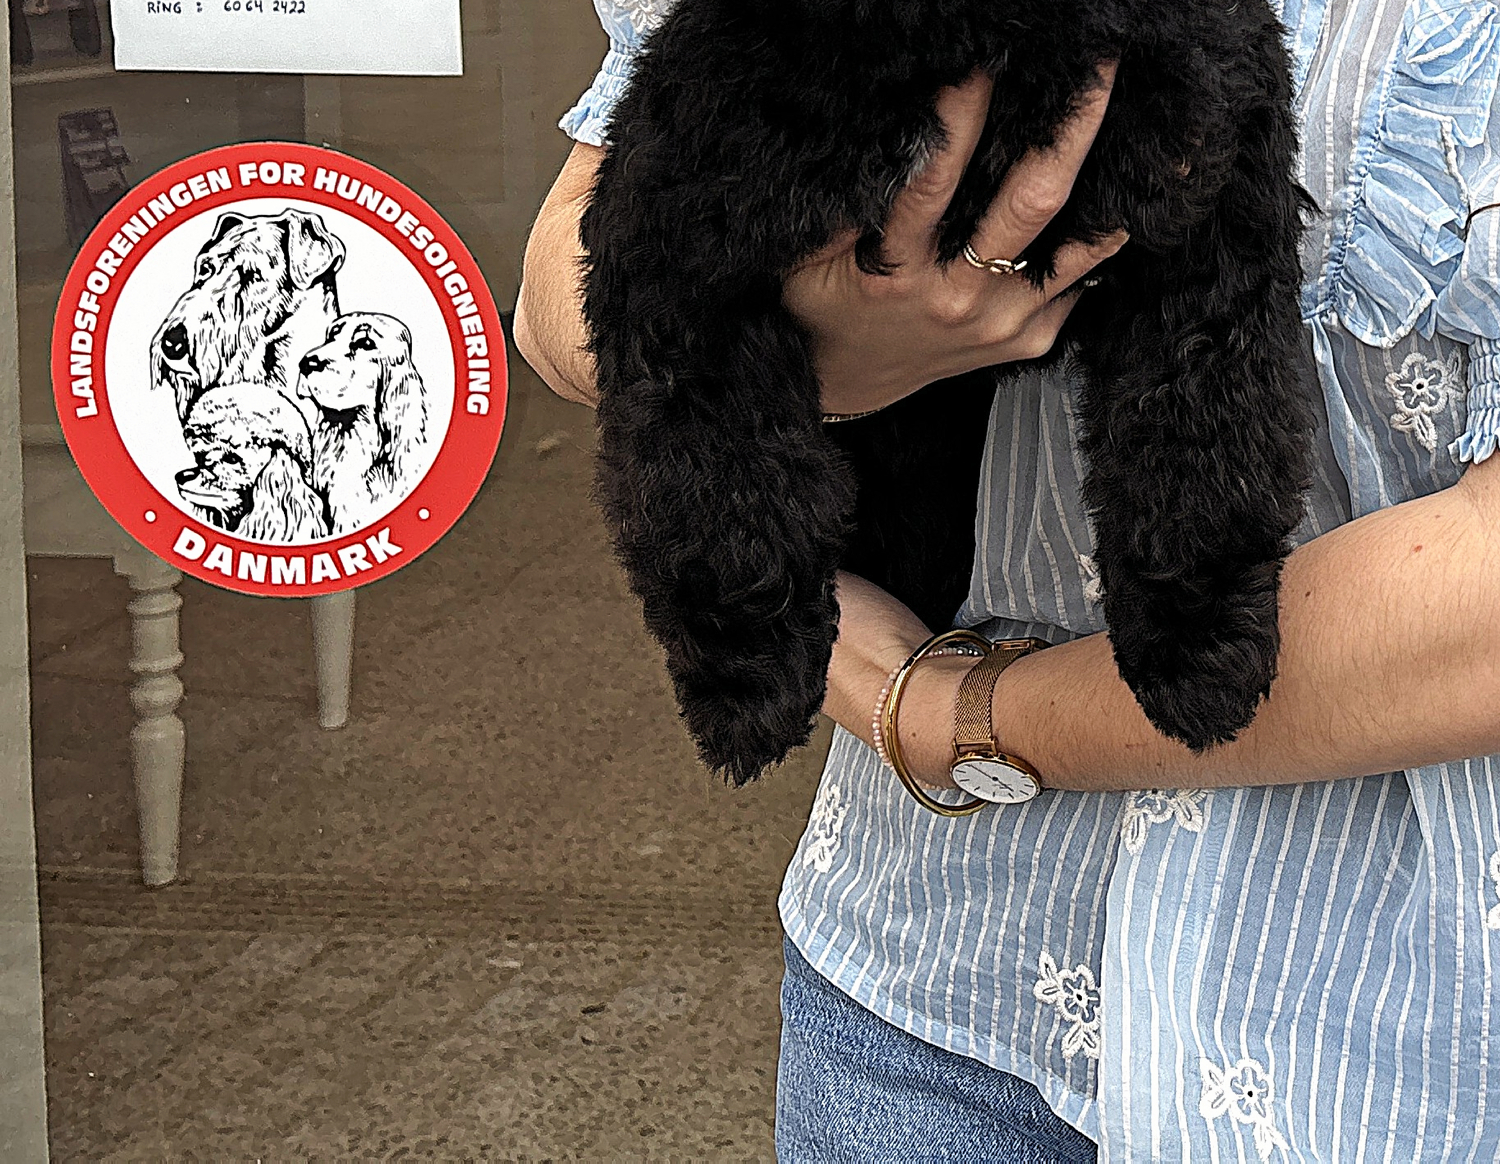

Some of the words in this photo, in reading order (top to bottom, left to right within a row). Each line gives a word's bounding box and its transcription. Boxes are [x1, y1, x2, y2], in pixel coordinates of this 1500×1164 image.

[273, 0, 306, 14] 2422
[70, 167, 232, 418] LANDSFORENINGEN
[240, 162, 305, 188] FOR
[313, 168, 491, 415] HUNDESOIGNERING
[172, 527, 403, 585] DANMARK
